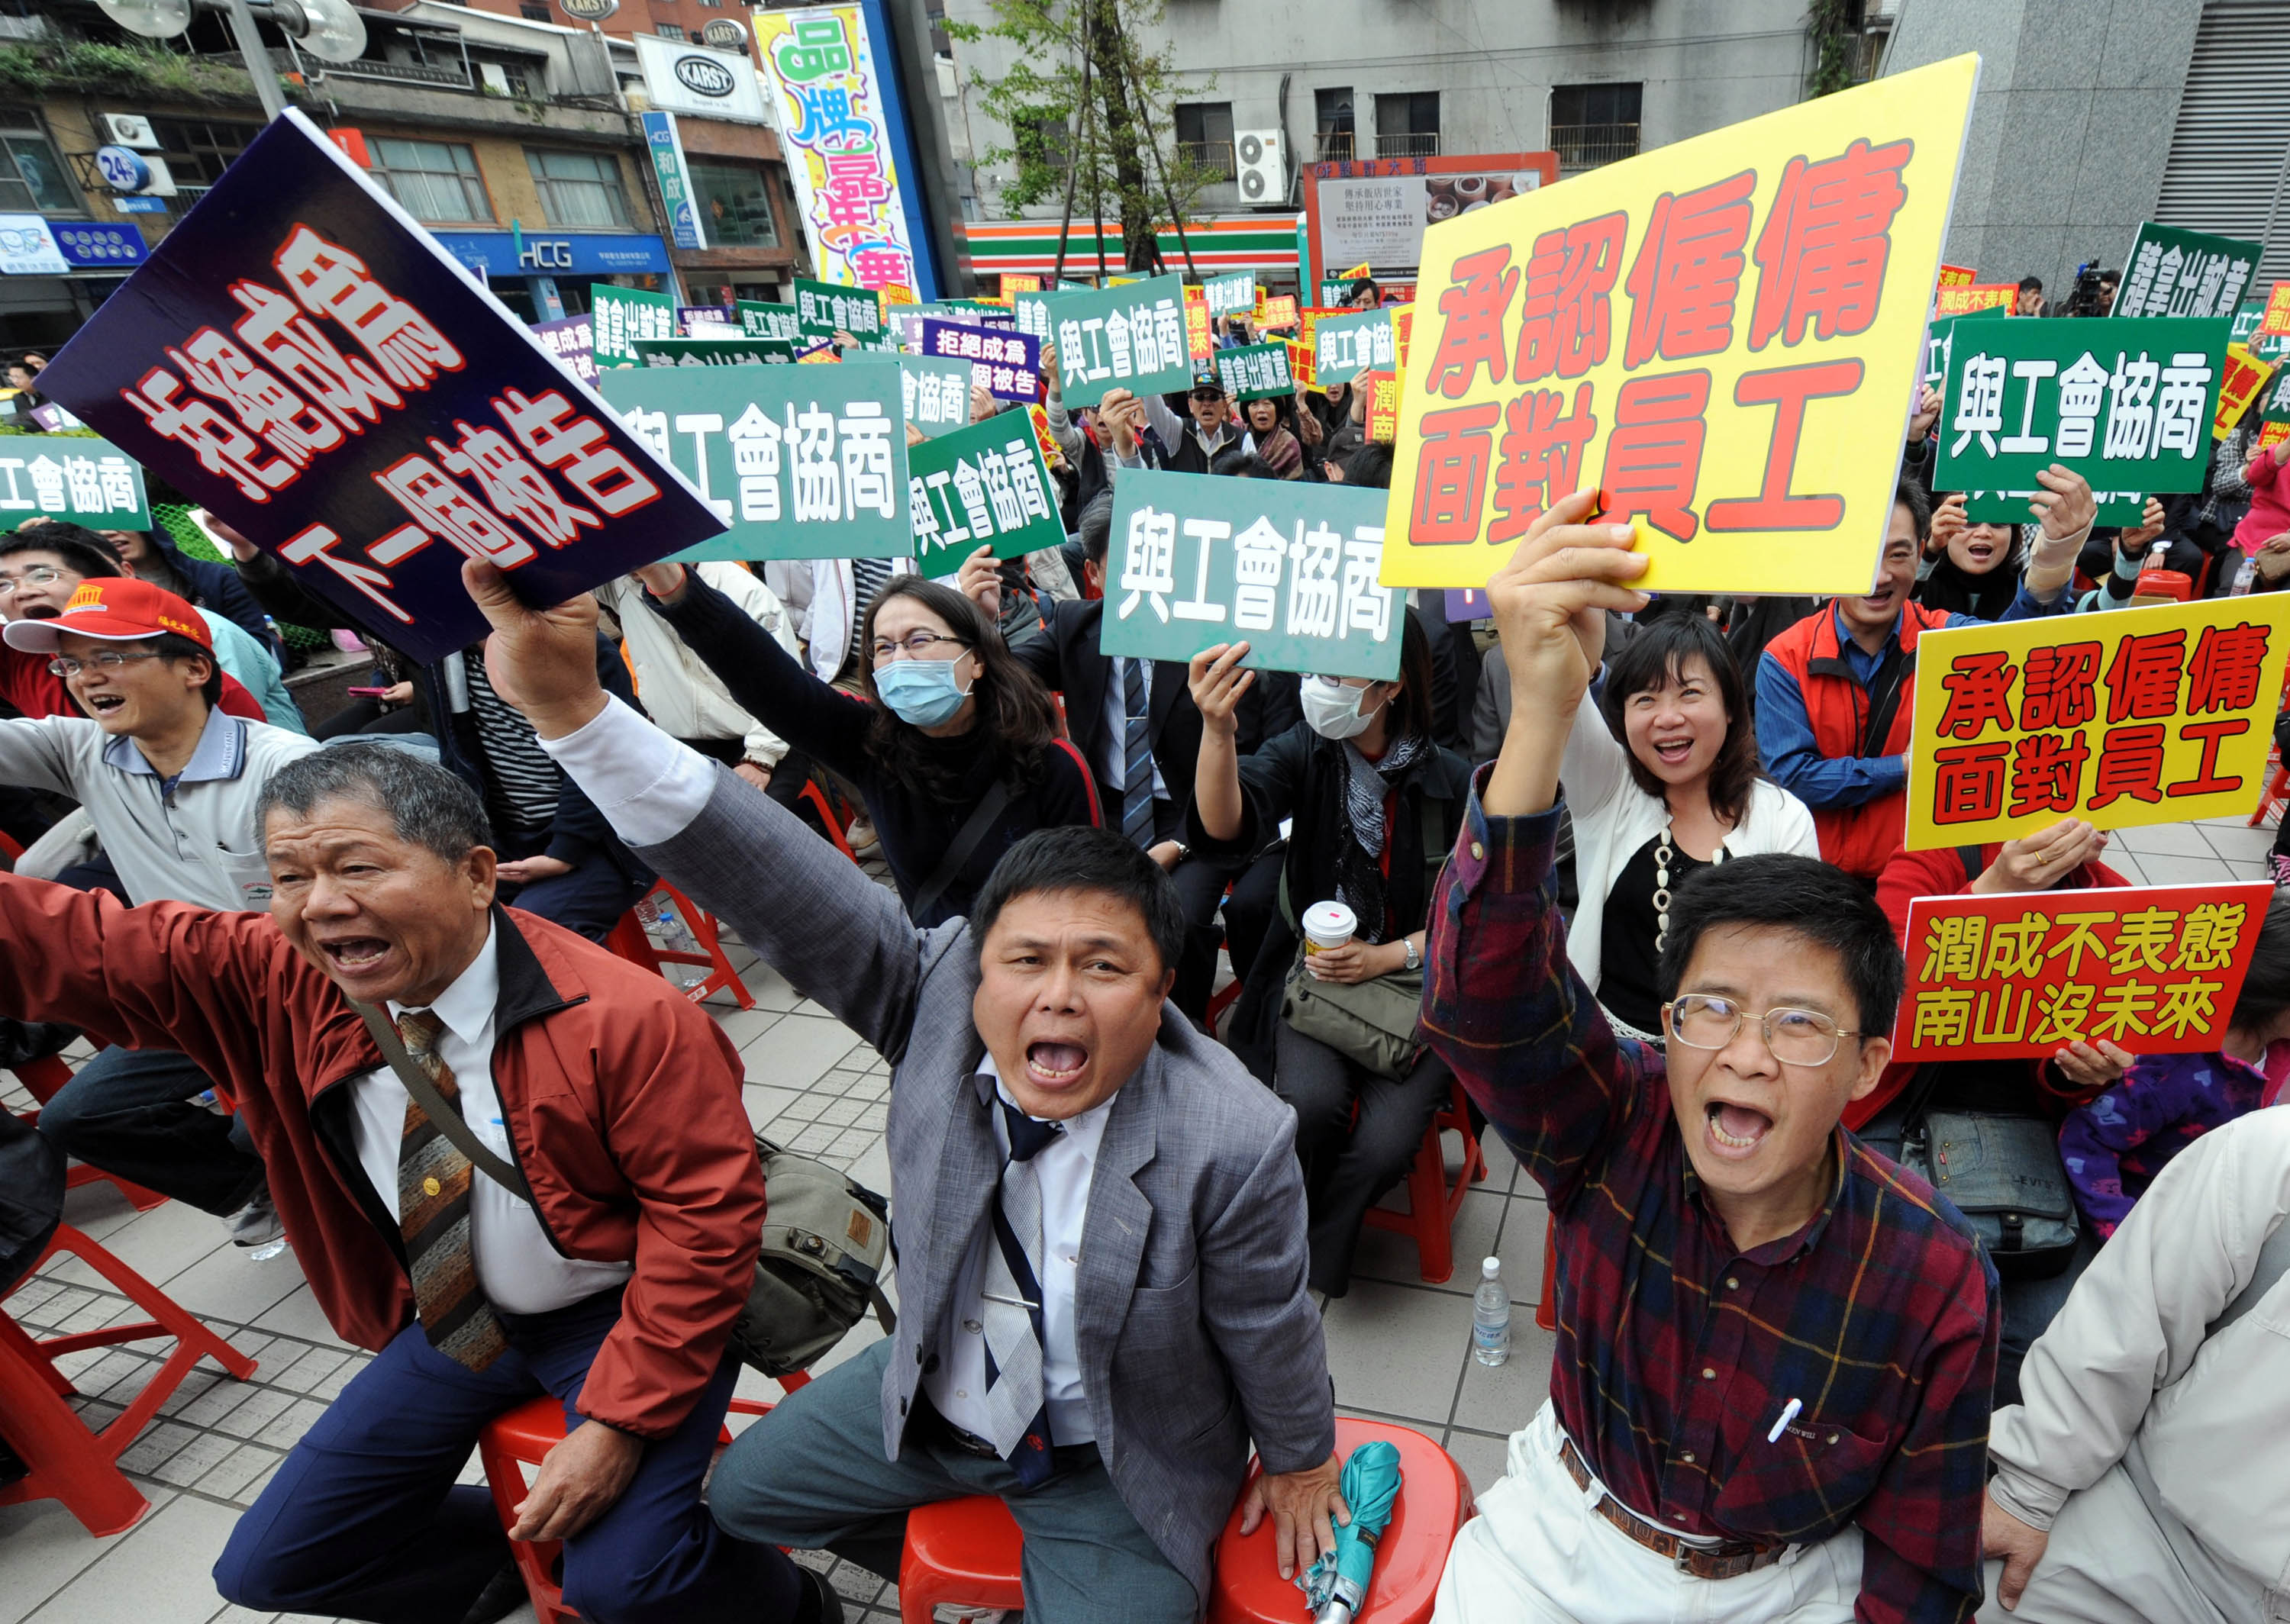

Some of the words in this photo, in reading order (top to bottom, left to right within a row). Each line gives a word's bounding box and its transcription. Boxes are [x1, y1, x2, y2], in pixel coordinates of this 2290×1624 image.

[708, 25, 737, 41] KARST
[680, 63, 728, 89] KARST
[657, 152, 682, 199] 和成
[1205, 276, 1253, 313] 請拿出誠意
[1426, 138, 1914, 398] 承認僱傭
[2120, 241, 2250, 317] 請拿出誠意
[799, 290, 879, 334] 與工會協商
[1018, 299, 1054, 342] 請拿
[1940, 289, 2014, 311] 潤成不表態
[1059, 299, 1184, 388] 與工會協商
[1218, 349, 1290, 396] 請拿出誠意
[1320, 321, 1394, 372] 與工會協
[971, 363, 1037, 395] 個被告
[1373, 380, 1395, 411] 潤
[1950, 350, 2212, 460] 與工會協商
[2214, 395, 2240, 429] 工
[1408, 359, 1865, 546] 面對員工
[0, 454, 138, 514] 工會協商
[279, 388, 662, 624] 下一個被告
[910, 438, 1050, 556] 與工會協商
[1118, 505, 1392, 643] 與工會協商
[1935, 621, 2272, 740] 承認僱傭
[1932, 718, 2250, 826] 面對員工
[1918, 902, 2247, 984] 潤成不表態
[1911, 975, 2224, 1050] 南山沒未來
